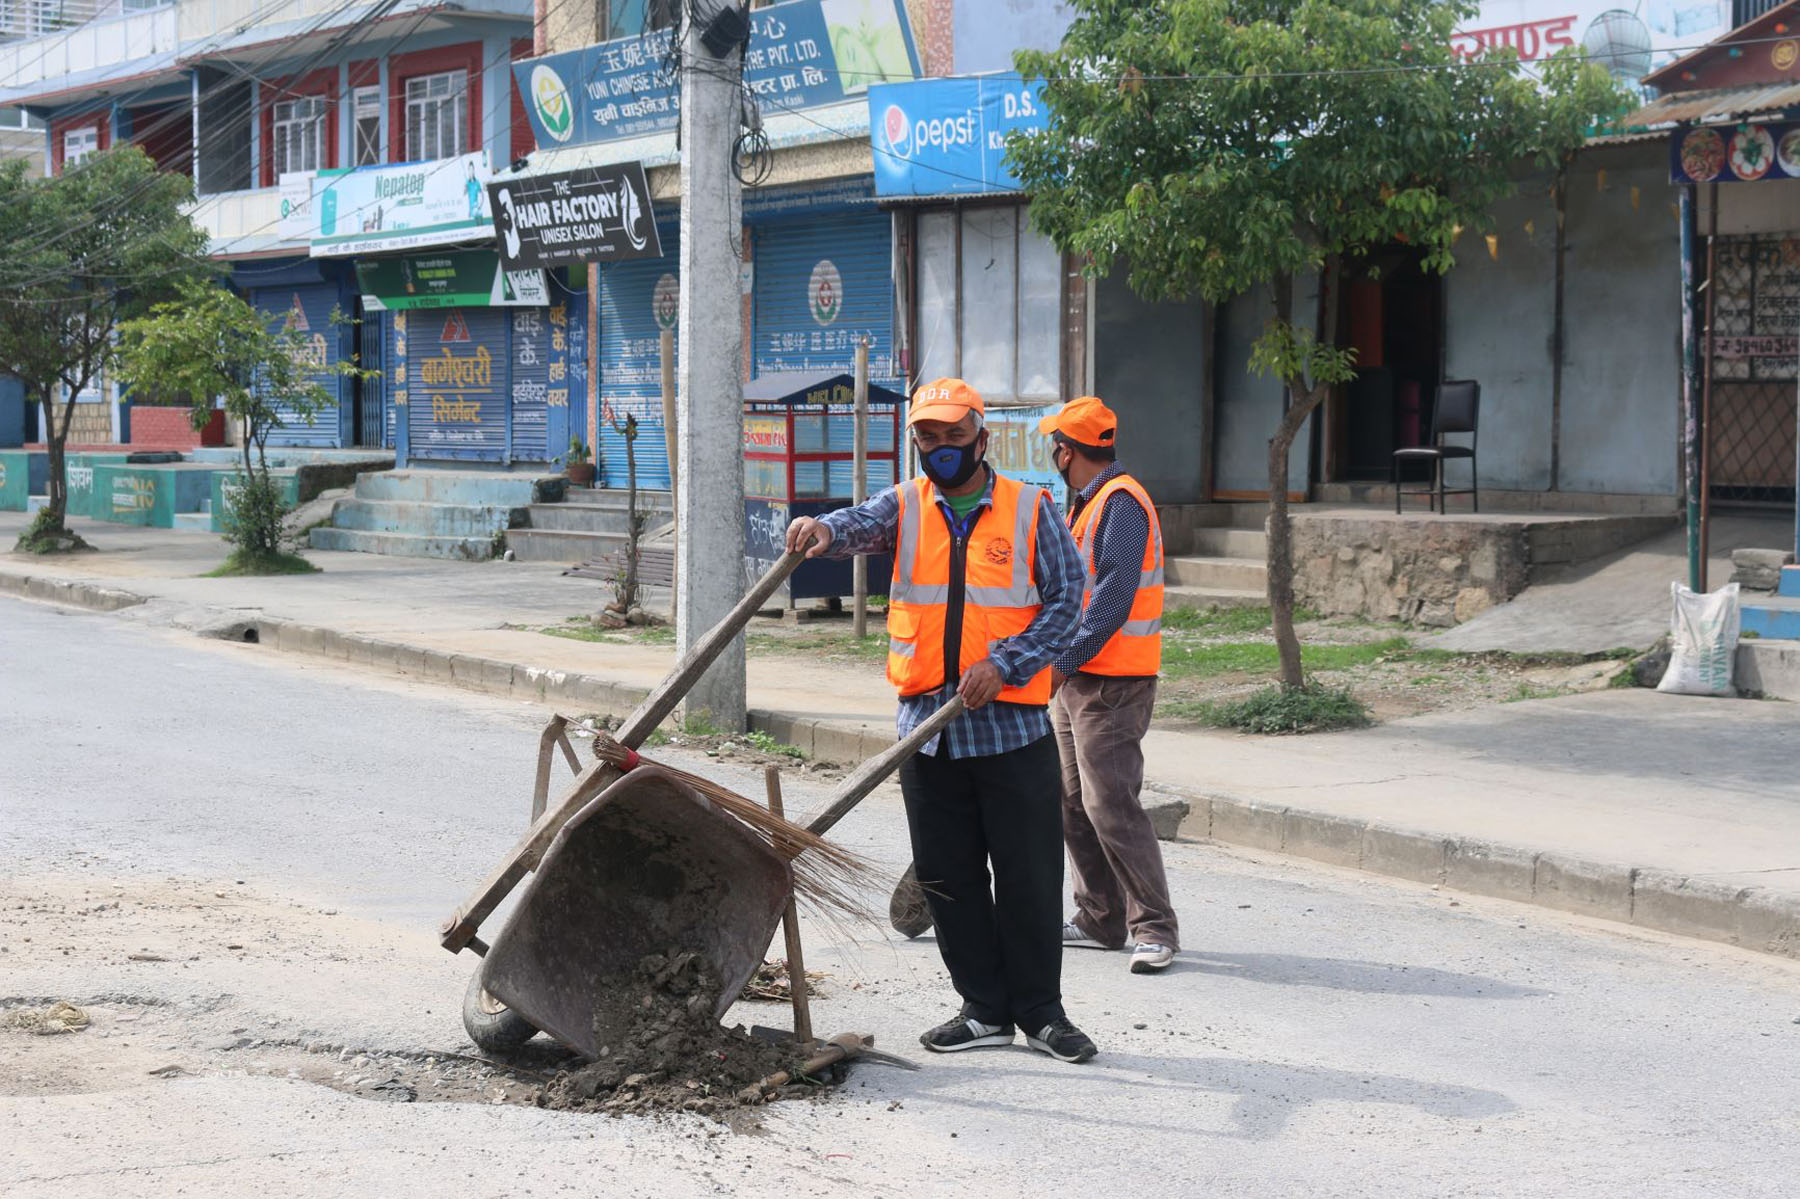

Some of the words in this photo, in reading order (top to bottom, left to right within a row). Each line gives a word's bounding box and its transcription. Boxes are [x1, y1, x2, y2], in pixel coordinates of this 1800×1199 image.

[585, 80, 610, 101] YUNI
[610, 71, 651, 97] CHINESE
[768, 43, 794, 67] PVT.
[795, 38, 821, 62] LTD.
[802, 65, 828, 88] लि.
[1004, 90, 1038, 119] D.S.
[915, 108, 973, 156] pepsi
[553, 180, 571, 196] THE
[516, 202, 552, 229] HAIR
[551, 191, 618, 225] FACTORY
[540, 224, 574, 245] UNISEX
[574, 222, 605, 241] SALON
